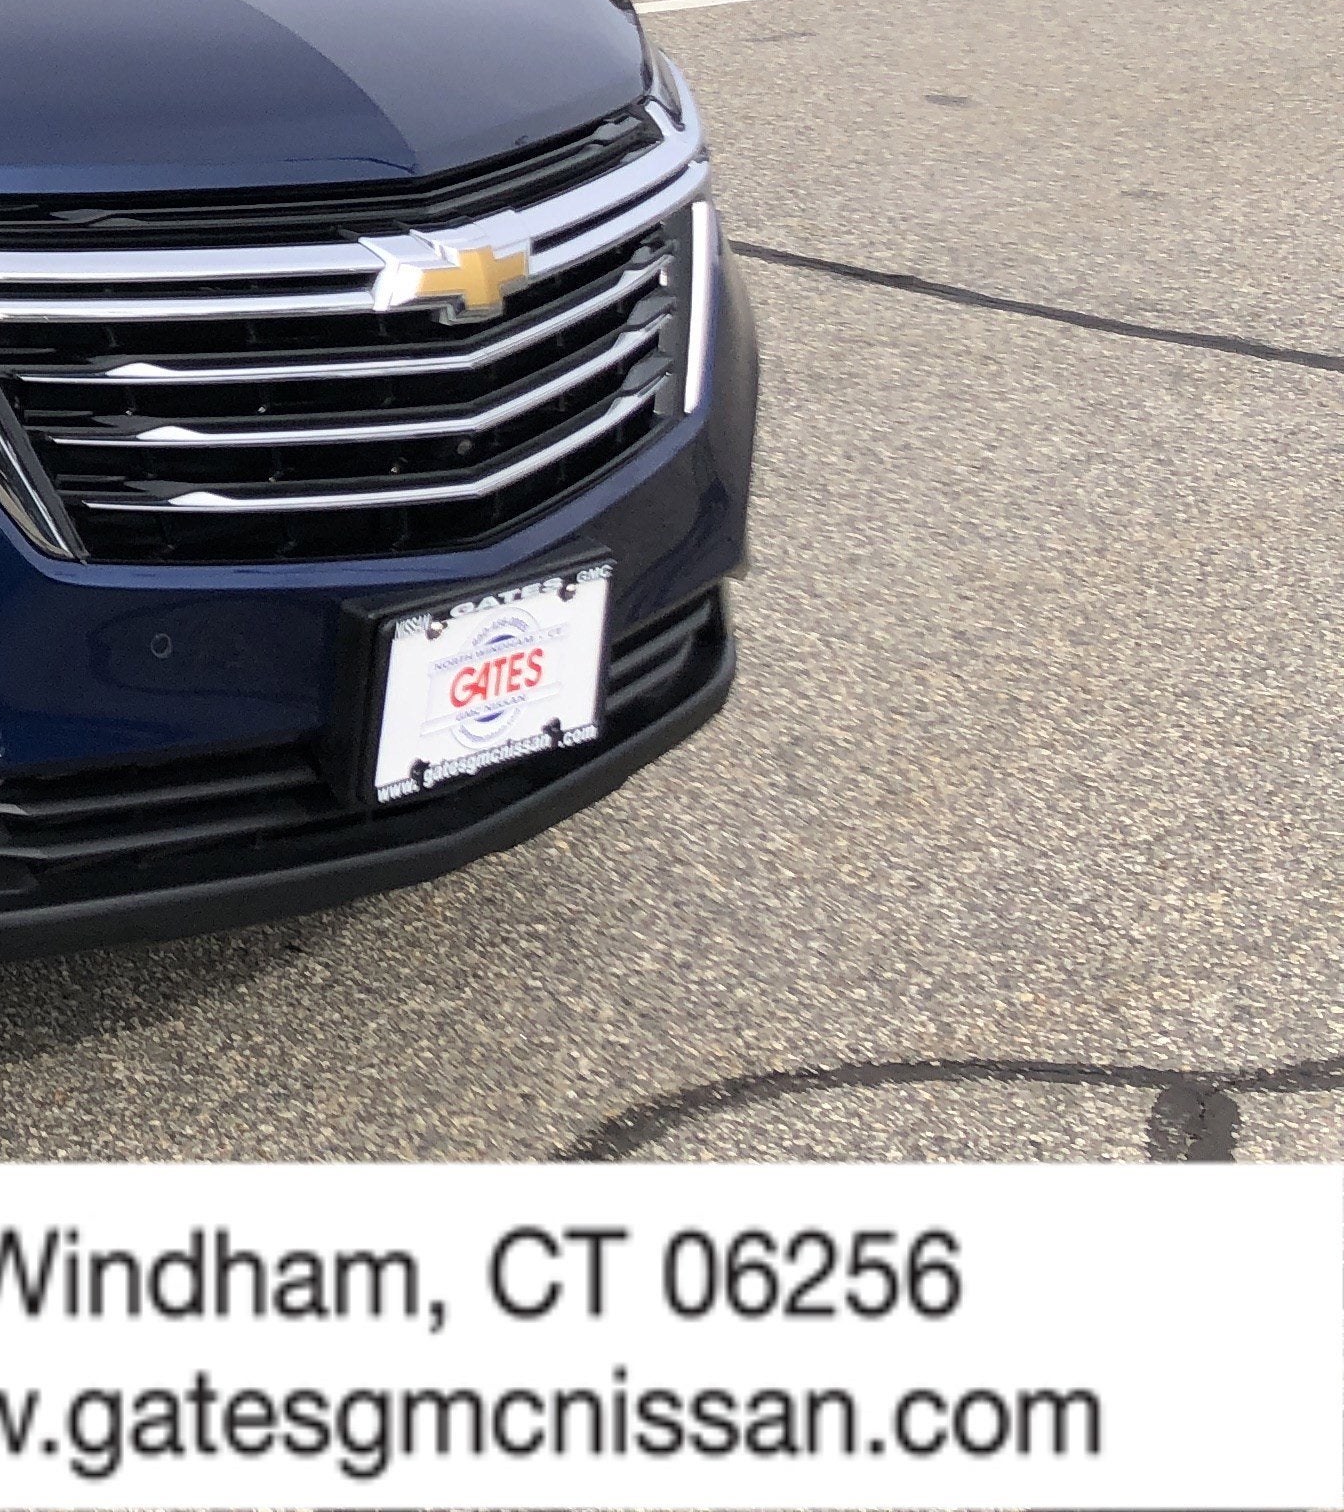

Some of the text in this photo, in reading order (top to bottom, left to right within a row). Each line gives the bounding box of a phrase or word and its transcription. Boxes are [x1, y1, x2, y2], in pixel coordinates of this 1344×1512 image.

[450, 577, 563, 619] GATES
[576, 564, 613, 584] GMC
[450, 647, 543, 708] GATES
